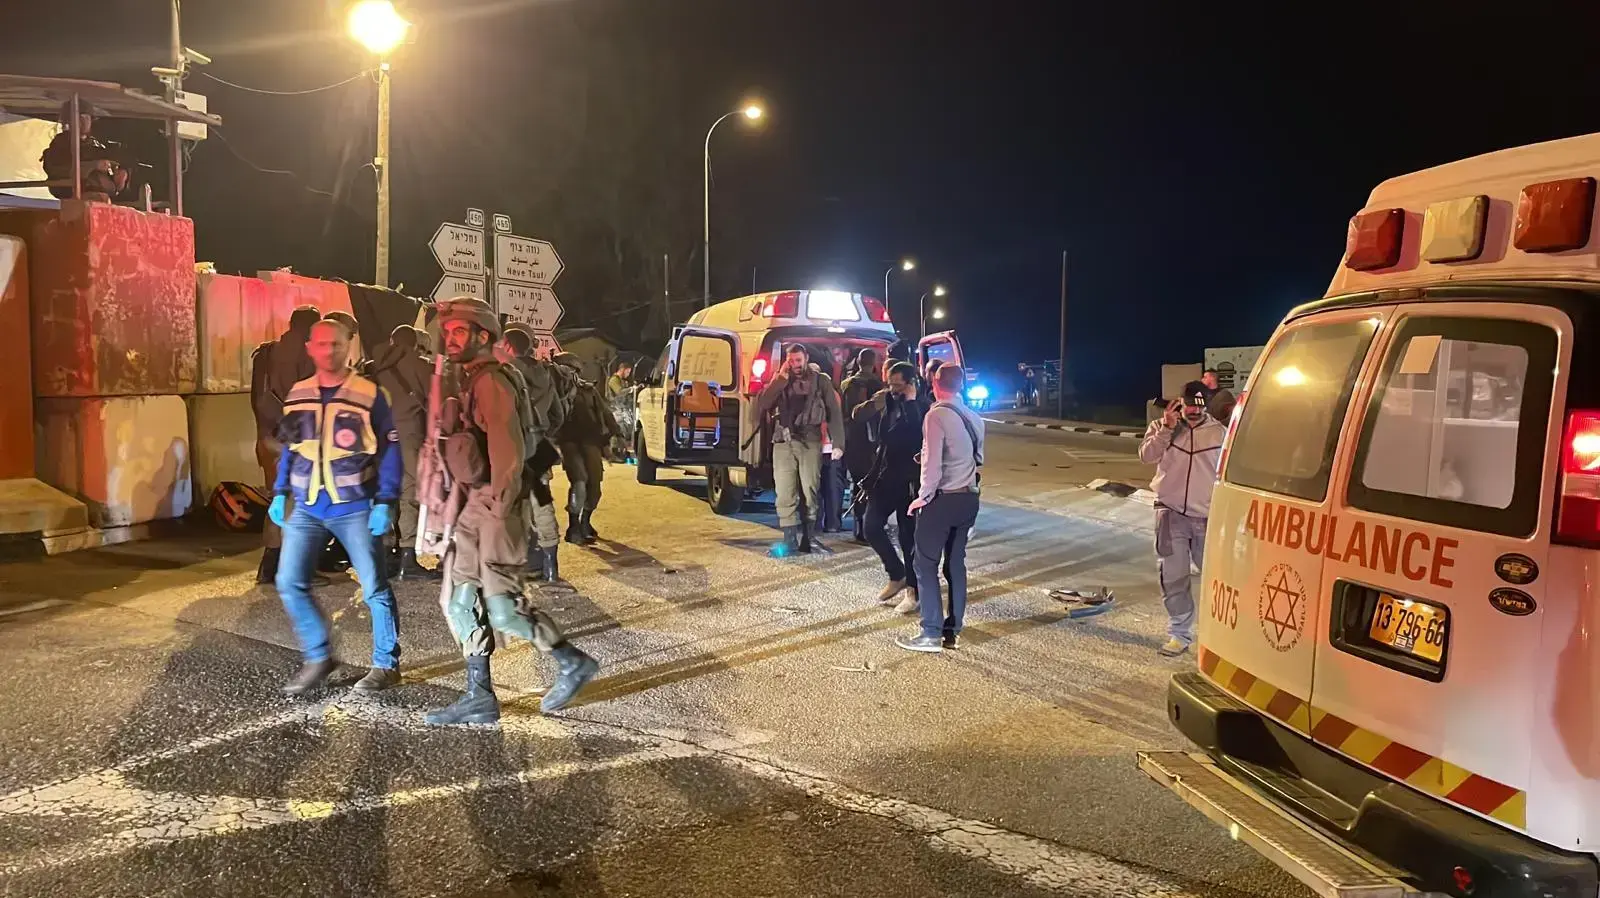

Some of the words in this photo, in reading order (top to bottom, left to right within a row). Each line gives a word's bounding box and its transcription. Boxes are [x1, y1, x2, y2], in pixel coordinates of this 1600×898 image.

[450, 230, 477, 244] נחליאל
[510, 242, 522, 252] צוף
[526, 245, 540, 255] נווה
[507, 267, 526, 277] Neve
[508, 289, 526, 298] אריה
[530, 292, 542, 301] בית
[526, 316, 543, 326] Arye
[1245, 500, 1459, 588] AMBULANCE
[1211, 579, 1239, 630] 3075
[1376, 603, 1444, 647] 13-796-66
